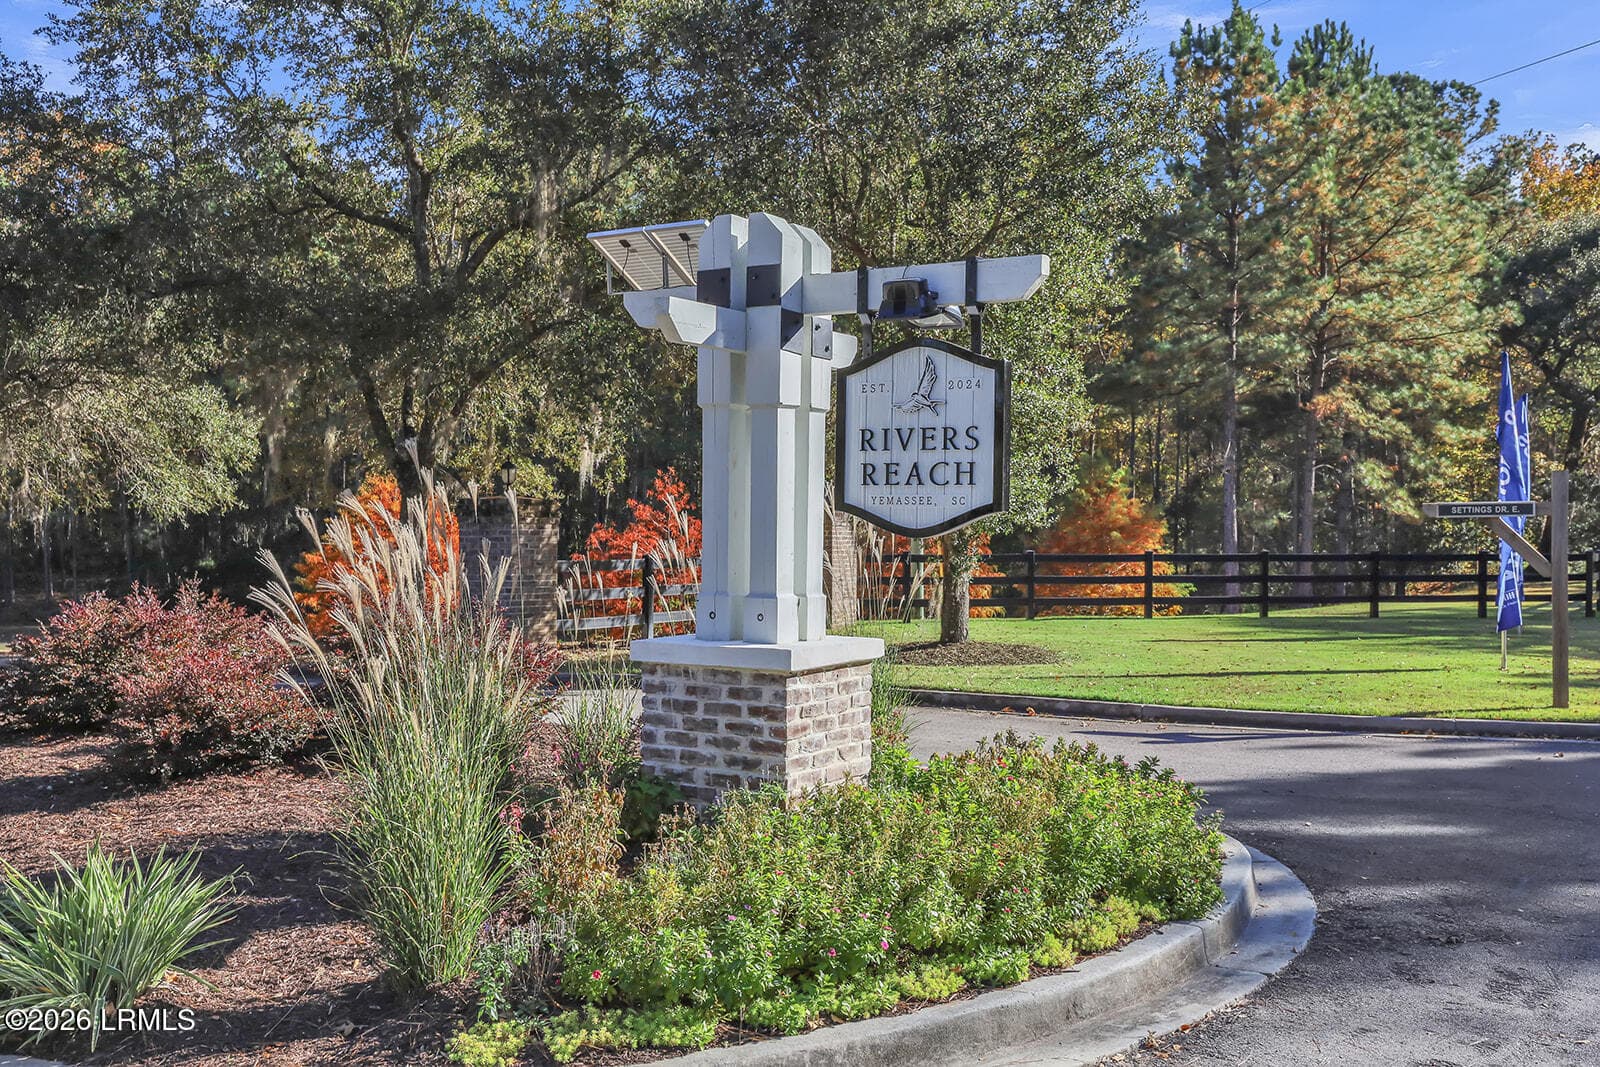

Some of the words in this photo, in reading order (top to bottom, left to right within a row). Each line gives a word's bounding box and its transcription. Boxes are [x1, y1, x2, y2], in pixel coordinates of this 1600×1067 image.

[861, 383, 890, 393] EST.
[948, 379, 982, 390] 2024
[859, 425, 980, 452] RIVERS
[860, 461, 977, 486] REACH
[871, 496, 937, 507] YEMASSEE,
[951, 496, 966, 506] SC
[1451, 506, 1492, 514] SETTINGS
[1495, 505, 1510, 513] DR.
[1512, 505, 1520, 513] E.
